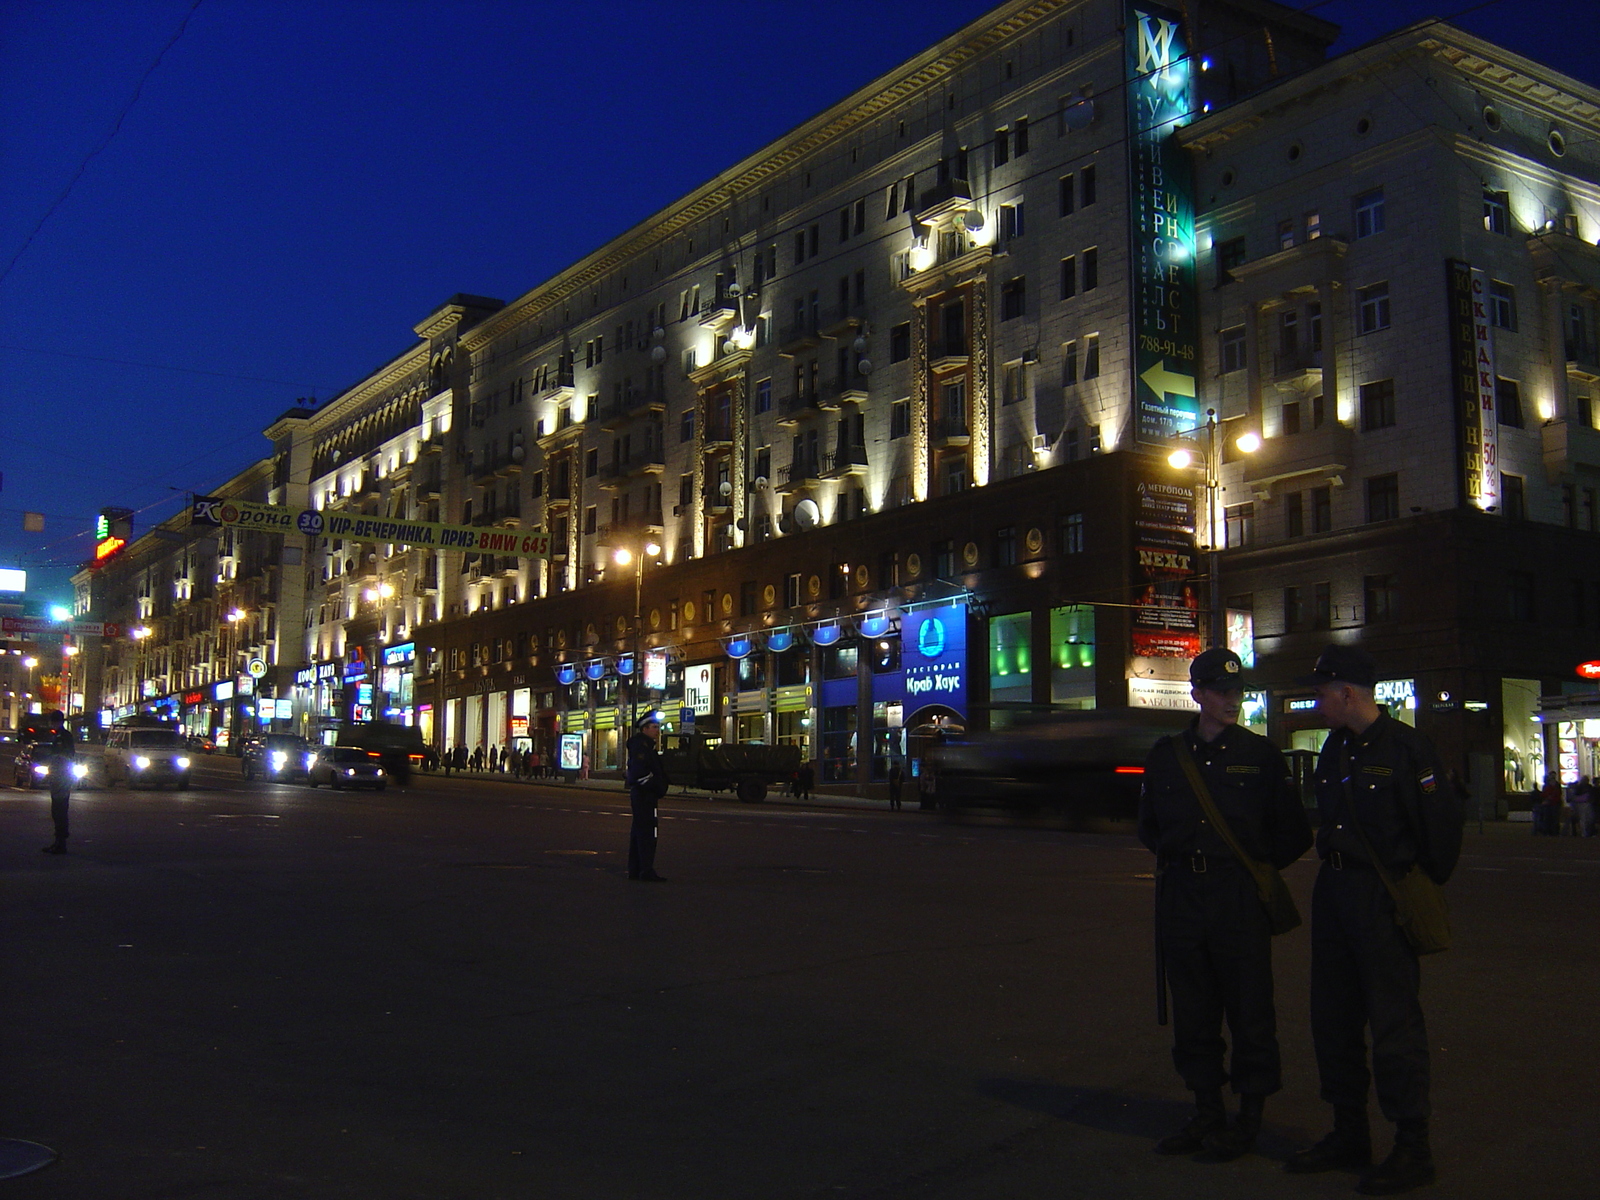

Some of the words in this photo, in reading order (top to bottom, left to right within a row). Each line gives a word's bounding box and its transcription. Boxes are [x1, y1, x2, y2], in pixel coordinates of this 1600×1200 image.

[1140, 335, 1194, 360] 788-91-48
[1483, 443, 1496, 466] 50
[300, 513, 323, 529] 30
[522, 535, 549, 554] 645
[1139, 550, 1191, 570] NEXT
[906, 675, 932, 696] Краб
[934, 674, 960, 693] Хаус
[1374, 681, 1413, 700] ЕЖДА
